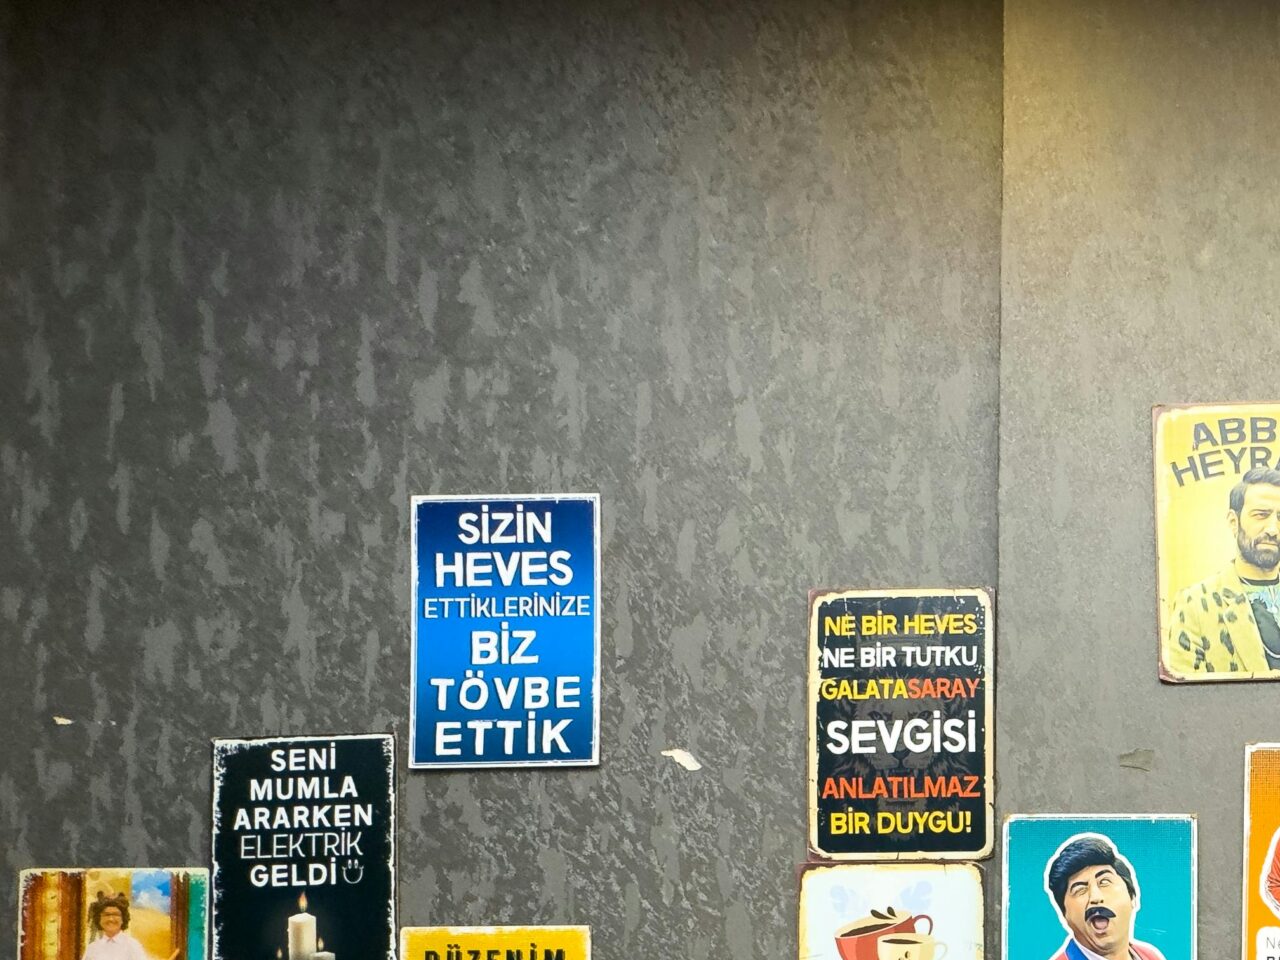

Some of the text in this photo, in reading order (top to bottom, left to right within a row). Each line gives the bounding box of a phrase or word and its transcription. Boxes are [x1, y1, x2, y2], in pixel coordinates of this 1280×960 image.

[458, 504, 552, 544] SİZİN
[436, 550, 573, 587] HEVES
[424, 592, 590, 618] ETTİKLERİNİZE
[824, 610, 977, 636] NE BİR HEVES
[471, 621, 539, 665] BİZ
[824, 642, 978, 668] NE BİR TUTKU
[430, 670, 580, 711] TÖVBE
[821, 678, 980, 700] GALATASARAY
[435, 711, 573, 756] ETTİK
[826, 710, 976, 754] SEVGİSİ
[271, 742, 336, 772] SENİ
[250, 776, 358, 801] MUMLA
[822, 776, 981, 799] ANLATILMAZ
[234, 803, 373, 830] ARARKEN
[830, 807, 971, 834] BİR DUYGU!
[240, 826, 363, 859] ELEKTRİK
[250, 857, 336, 887] GELDİ
